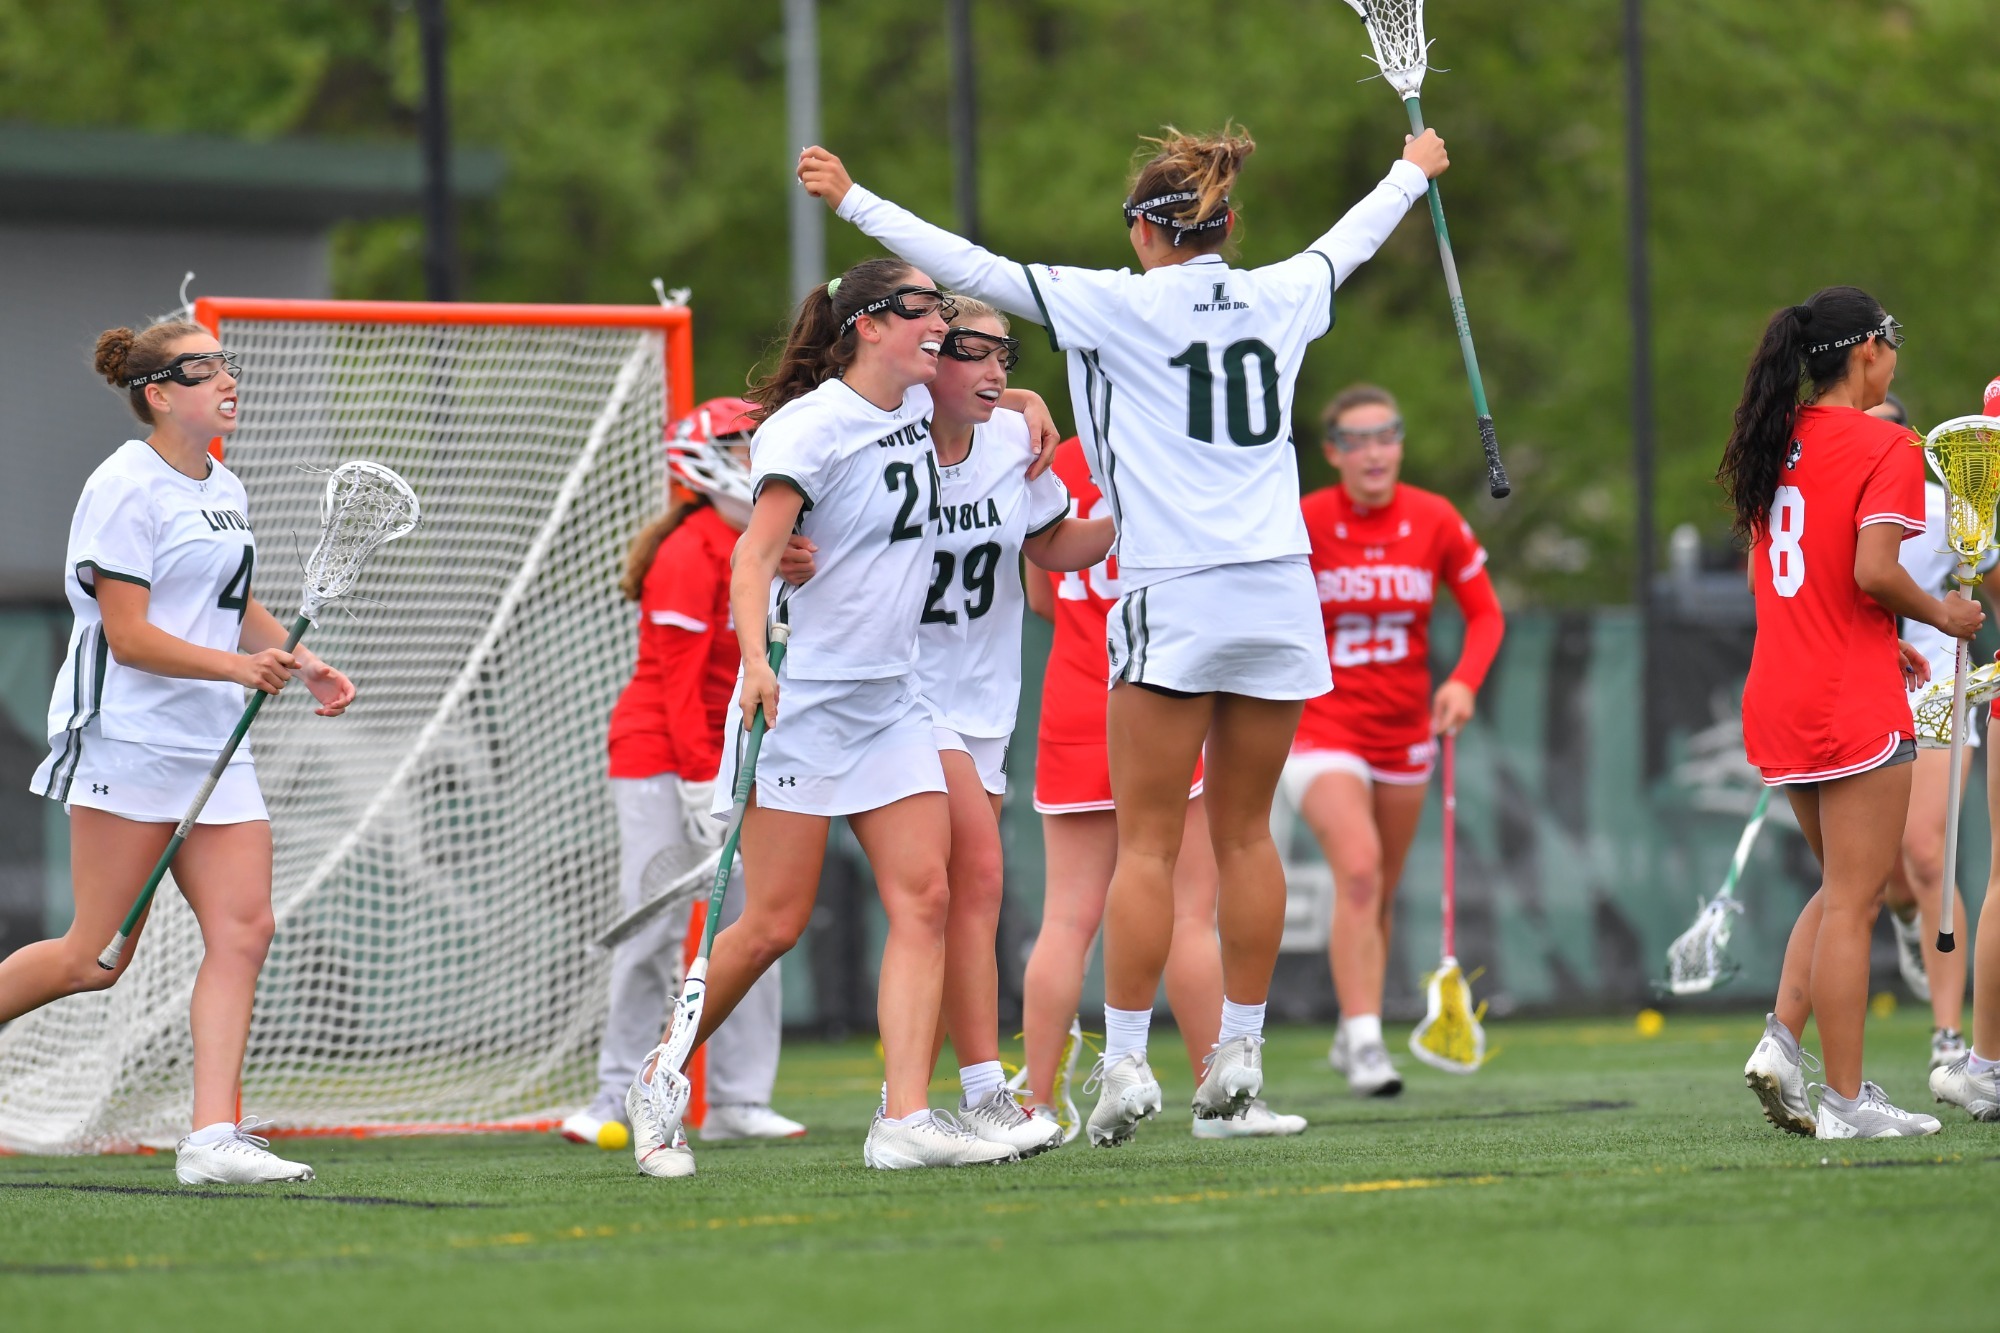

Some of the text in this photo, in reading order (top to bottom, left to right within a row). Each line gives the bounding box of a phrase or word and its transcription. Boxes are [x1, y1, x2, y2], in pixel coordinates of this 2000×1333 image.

[1146, 212, 1168, 226] GAIT
[1212, 282, 1230, 303] L
[1218, 302, 1231, 312] NO
[846, 308, 865, 327] GAIT
[867, 298, 891, 313] GAIT
[1834, 334, 1862, 349] GAIT
[133, 369, 172, 386] GAIT GAIT
[1167, 337, 1283, 448] 10
[1769, 486, 1806, 598] 8
[217, 544, 255, 626] 4
[919, 541, 1003, 627] 29
[1316, 564, 1434, 604] BOSTON
[1331, 610, 1416, 668] 25
[713, 868, 729, 905] GAIT
